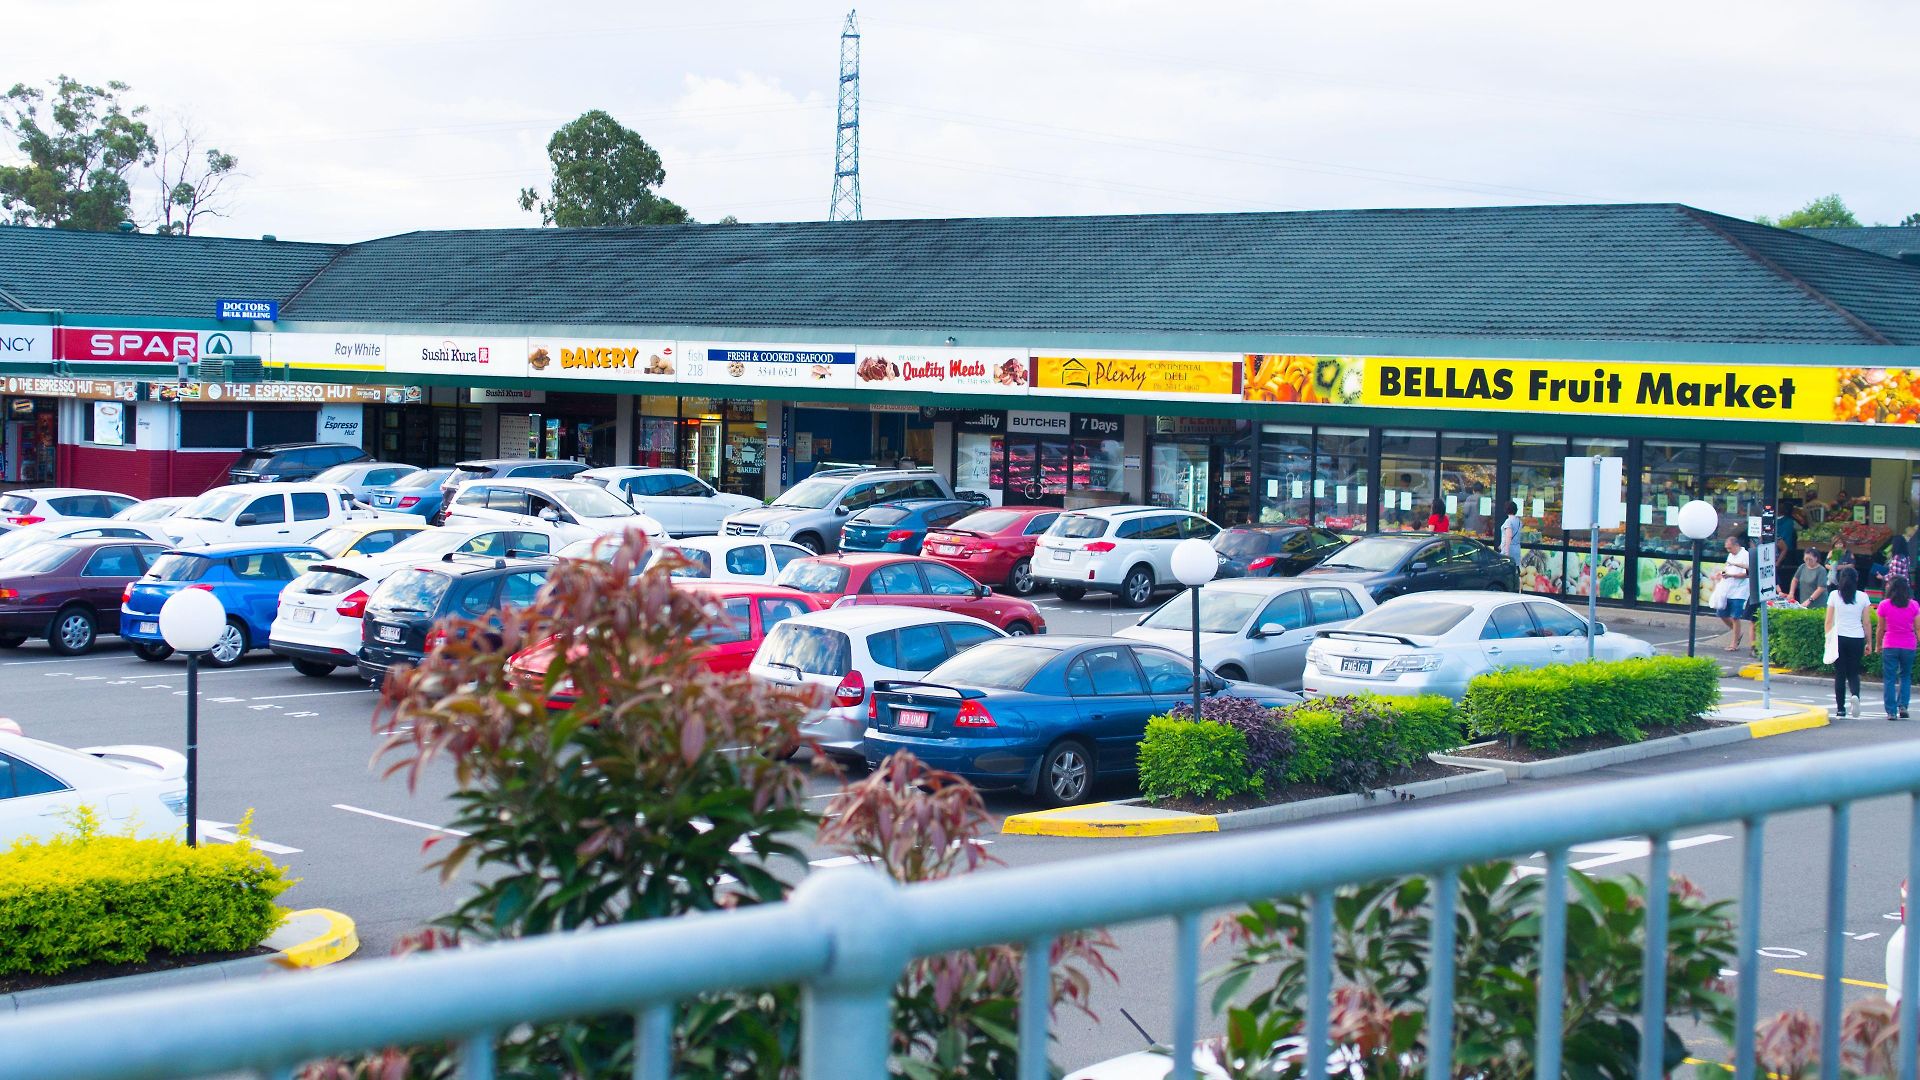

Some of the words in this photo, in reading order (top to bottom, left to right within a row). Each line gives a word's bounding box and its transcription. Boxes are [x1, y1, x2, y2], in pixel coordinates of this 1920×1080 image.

[223, 302, 271, 312] DOCTORS
[242, 311, 271, 319] BILLING
[91, 334, 197, 357] SPAR
[335, 342, 352, 358] Ray
[354, 343, 381, 357] White
[422, 348, 449, 361] Sushi
[451, 349, 477, 362] Kura
[560, 347, 639, 369] BAKERY
[687, 348, 703, 362] fish
[727, 351, 750, 362] FRESH
[752, 352, 759, 362] &
[760, 352, 794, 363] COOKED
[795, 353, 834, 363] SEAFOOD
[687, 364, 703, 376] 218
[902, 361, 945, 382] Quality
[950, 359, 986, 378] Meats
[1148, 362, 1201, 371] CONTINENTAL
[1096, 361, 1147, 391] Plenty
[1164, 372, 1188, 381] DELI
[17, 378, 33, 391] THE
[34, 379, 76, 393] ESPRESSO
[77, 380, 94, 394] HUT
[225, 384, 253, 397] THE
[255, 384, 324, 398] ESPRESSO
[327, 385, 353, 398] HUT
[485, 389, 505, 397] Sushi
[1379, 366, 1514, 401] BELLAS
[1529, 368, 1622, 404] Fruit
[1635, 371, 1797, 410] Market
[324, 421, 358, 430] Espresso
[1013, 417, 1066, 428] BUTCHER
[1080, 418, 1087, 430] 7
[1091, 418, 1118, 434] Days
[736, 466, 762, 474] BAKERY
